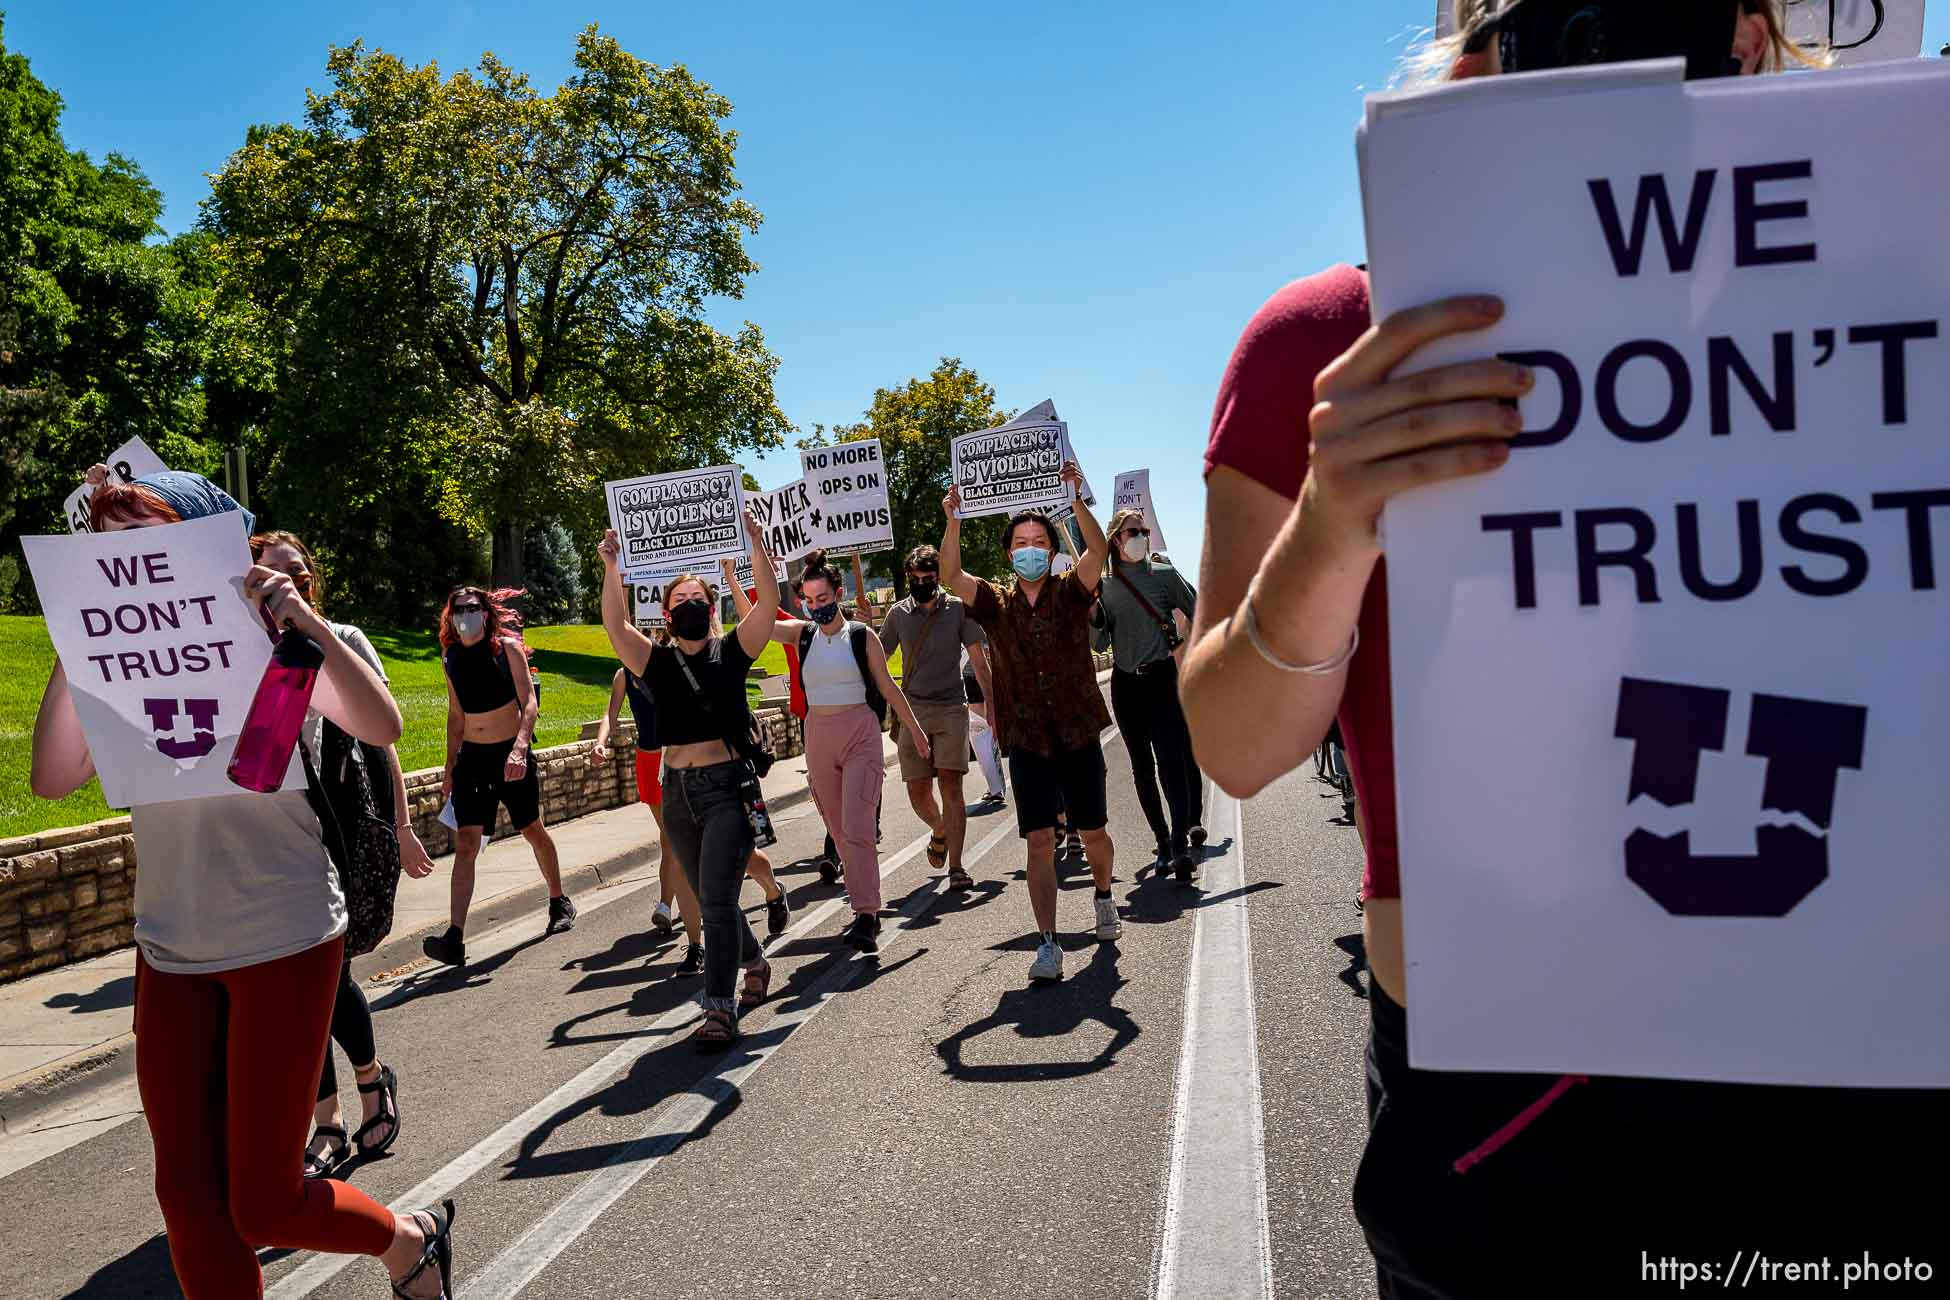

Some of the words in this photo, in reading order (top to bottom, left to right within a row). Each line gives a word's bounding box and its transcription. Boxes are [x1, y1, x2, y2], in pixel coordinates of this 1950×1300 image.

[1588, 159, 1816, 277] WE
[806, 454, 827, 470] NO
[832, 446, 877, 466] MORE
[960, 430, 1058, 461] COMPLACENCY
[960, 461, 976, 485] IS
[979, 449, 1060, 482] VIOLENCE
[620, 477, 731, 512] COMPLACENCY
[818, 477, 852, 495] OPS
[857, 473, 879, 489] ON
[965, 486, 995, 498] BLACK
[996, 481, 1022, 494] LIVES
[1023, 475, 1059, 490] MATTER
[1117, 493, 1141, 505] DON'T
[1123, 480, 1135, 490] WE
[625, 511, 643, 537] IS
[646, 499, 735, 534] VIOLENCE
[778, 482, 811, 521] HER
[826, 508, 890, 533] AMPUS
[631, 553, 653, 562] DEFUND
[654, 551, 667, 559] AND
[719, 541, 738, 549] POLICE
[632, 539, 665, 553] BLACK
[666, 533, 693, 547] LIVES
[695, 527, 735, 541] MATTER
[1481, 489, 1950, 609] TRUST
[96, 552, 174, 588] WE
[80, 595, 216, 638] DON'T
[88, 640, 234, 682] TRUST
